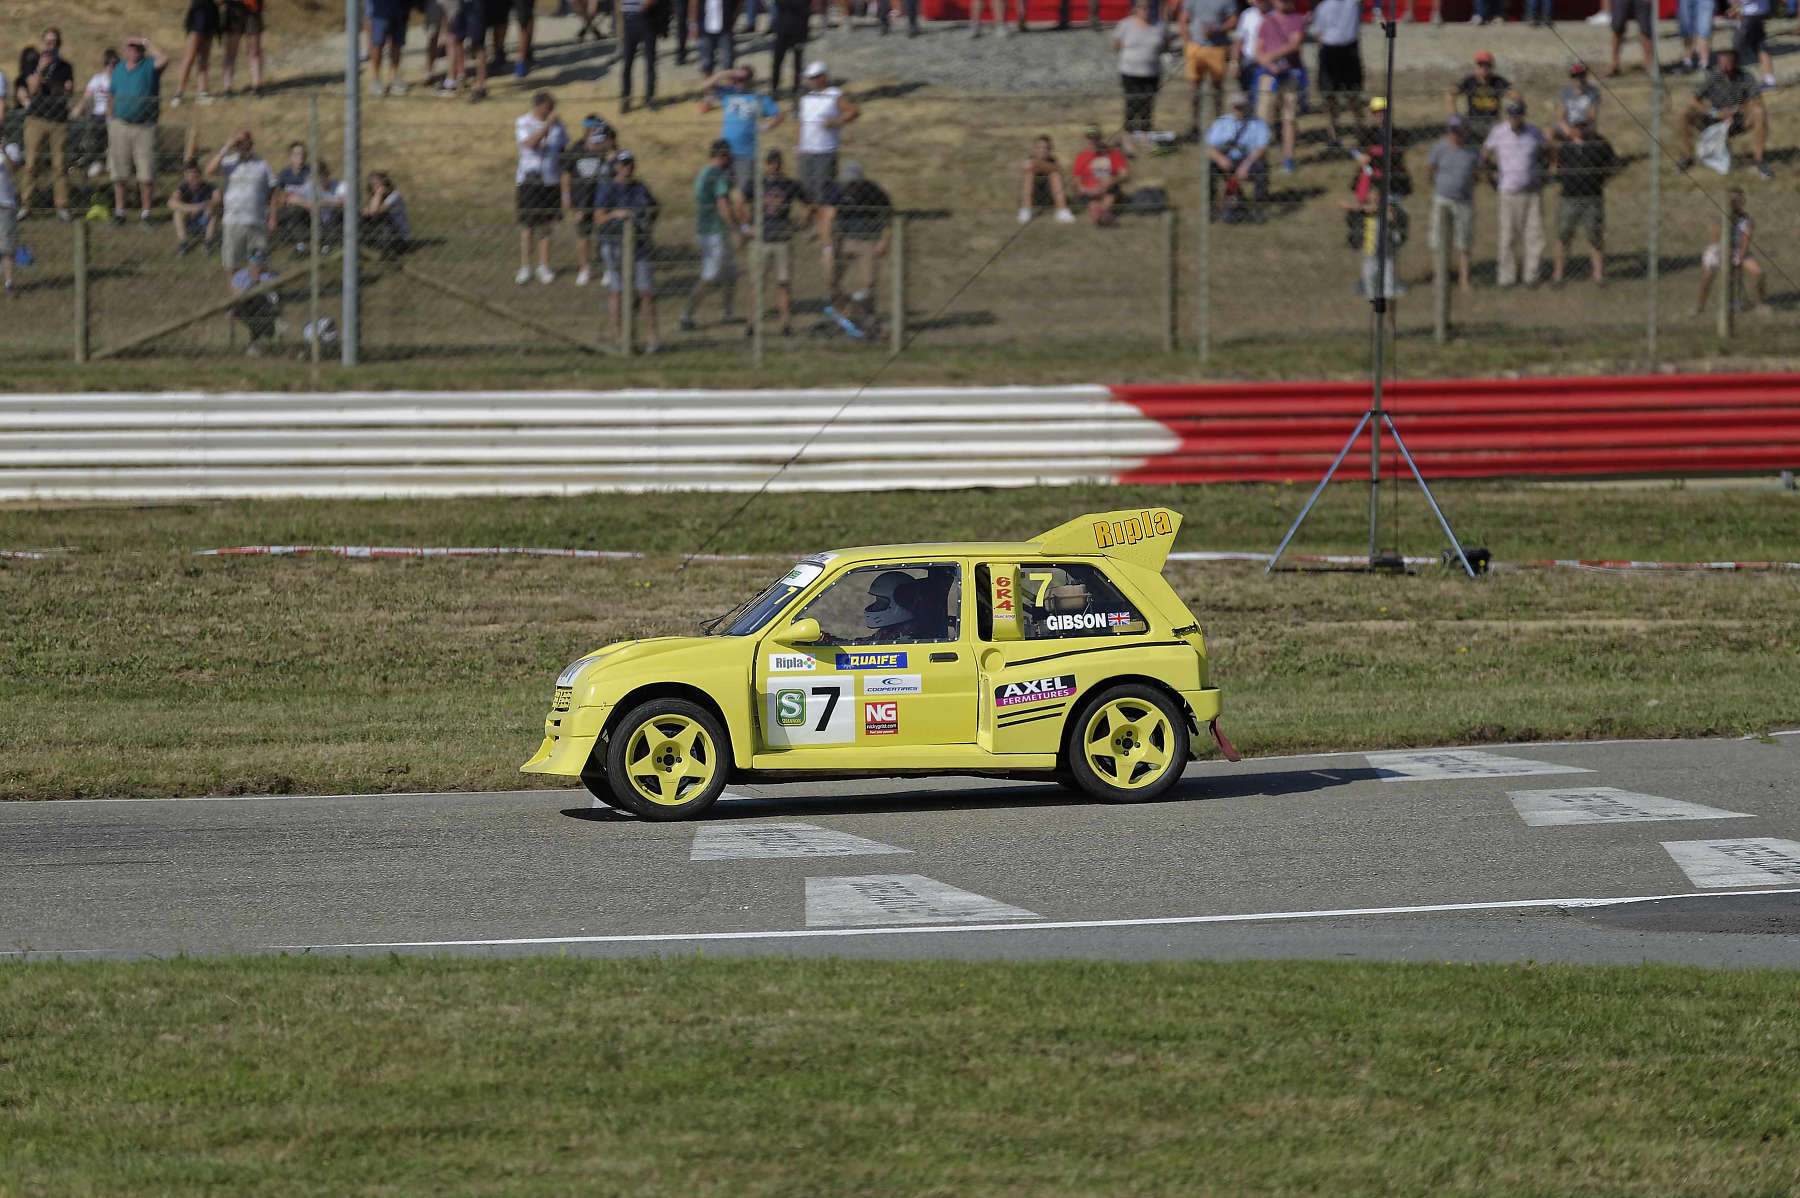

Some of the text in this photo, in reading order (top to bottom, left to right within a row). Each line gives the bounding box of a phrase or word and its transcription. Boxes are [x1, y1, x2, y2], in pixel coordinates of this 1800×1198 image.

[1093, 511, 1173, 549] Ripla
[1028, 572, 1053, 608] 7
[1046, 612, 1107, 631] GIBSON
[775, 656, 804, 669] Ripla
[850, 655, 898, 666] QUAIFE
[1003, 677, 1068, 698] AXEL
[1003, 689, 1070, 705] FERMETURES
[812, 687, 841, 731] 7
[866, 703, 897, 722] NG
